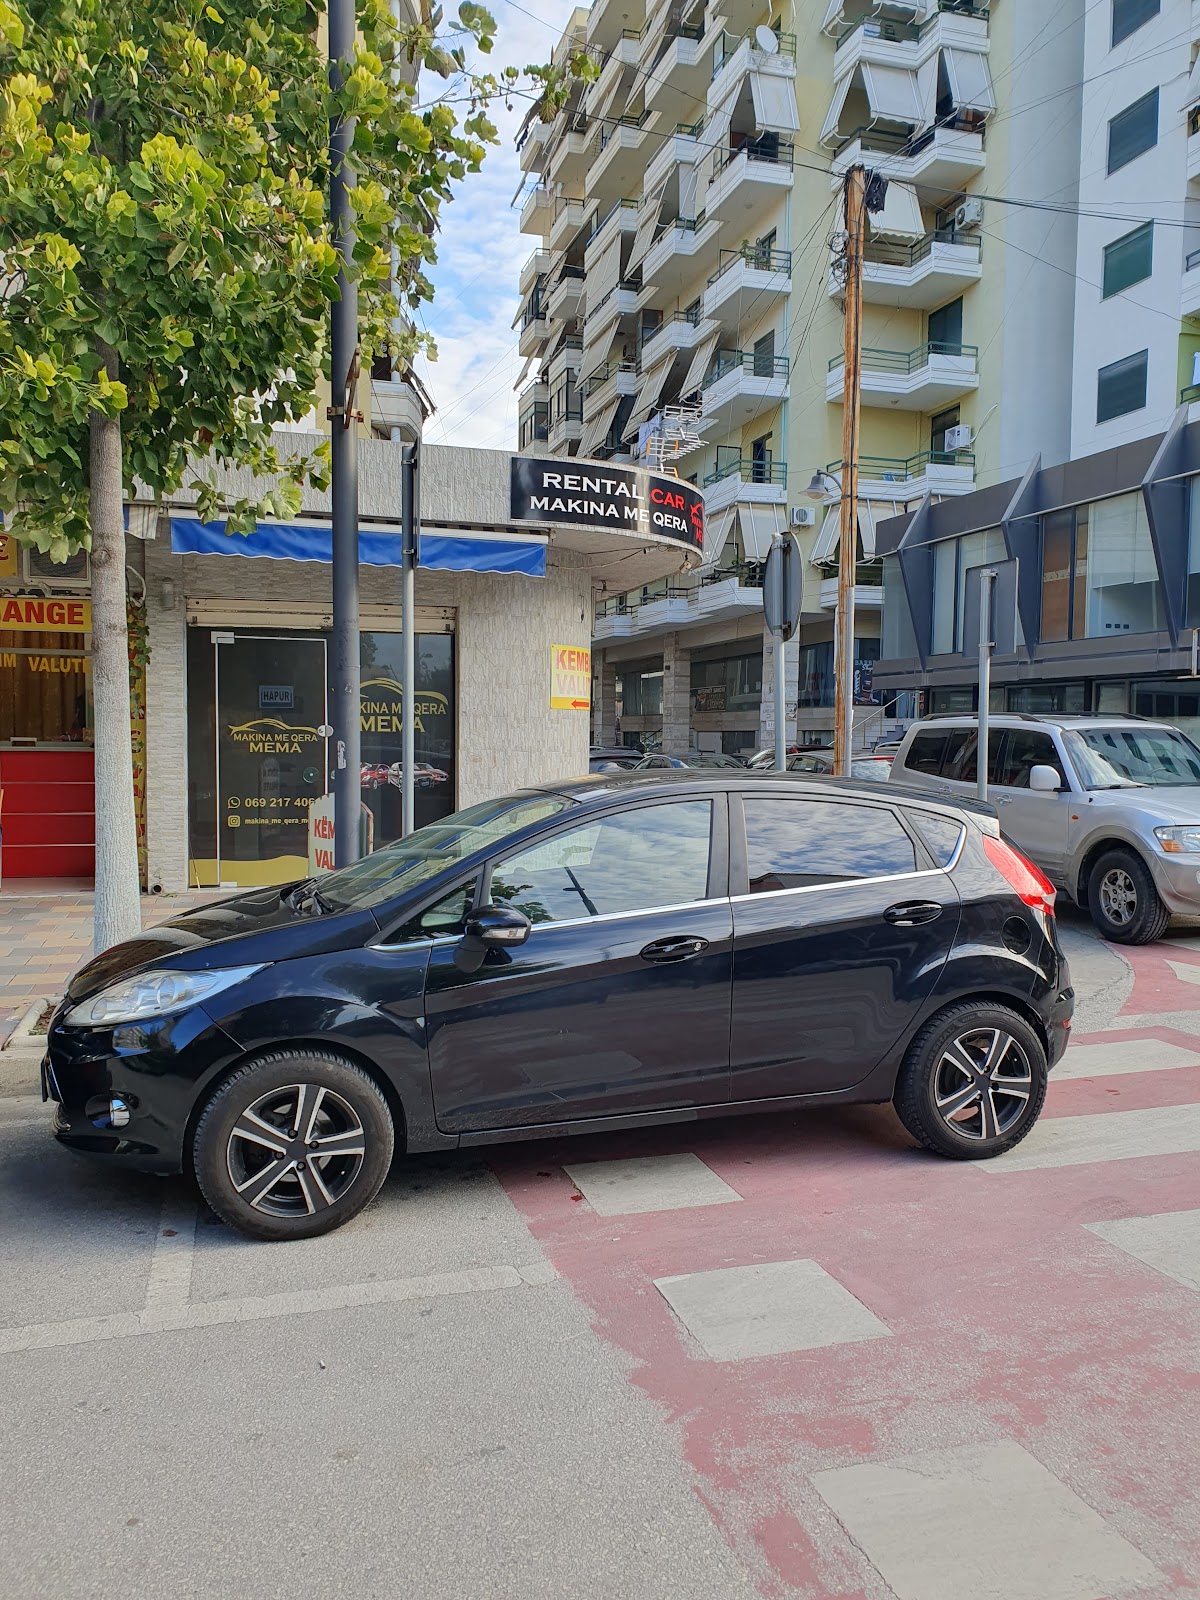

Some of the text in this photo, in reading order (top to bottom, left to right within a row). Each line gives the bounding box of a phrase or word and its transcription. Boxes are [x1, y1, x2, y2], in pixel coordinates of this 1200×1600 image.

[542, 472, 685, 511] RENTAL CAR
[530, 495, 620, 519] MAKINA
[624, 506, 650, 523] ME
[652, 511, 689, 533] QERA
[0, 600, 84, 625] ANGE
[263, 691, 290, 701] HAPUR
[360, 715, 426, 733] MEMA
[233, 733, 318, 743] MAKINA ME QERA
[249, 742, 303, 753] MEMA
[244, 797, 267, 808] 069
[269, 797, 291, 808] 217
[314, 848, 336, 871] VAL
